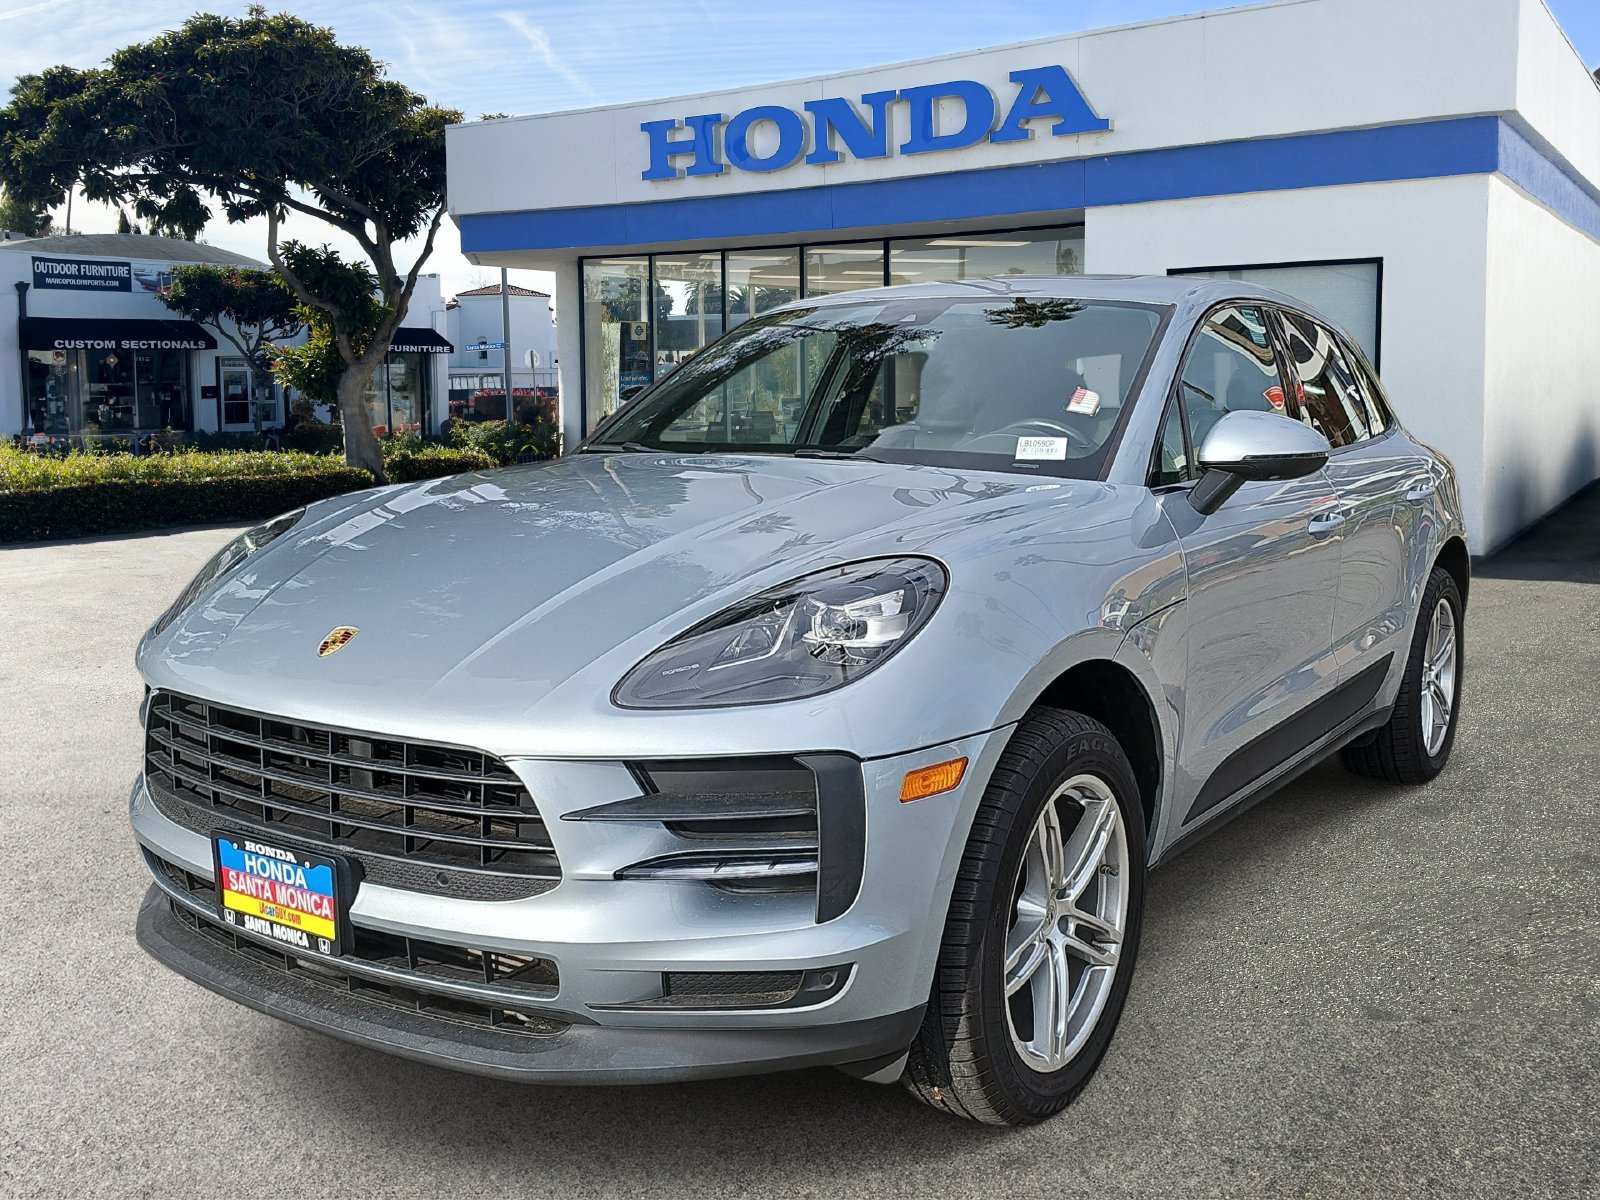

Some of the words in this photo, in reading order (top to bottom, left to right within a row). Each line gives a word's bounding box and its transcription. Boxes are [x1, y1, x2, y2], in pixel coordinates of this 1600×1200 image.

[640, 64, 1113, 182] HONDA
[34, 261, 79, 275] OUTDOOR
[80, 264, 130, 278] FURNITURE
[45, 277, 119, 287] MARCOPOLOIMPORTS.COM
[54, 339, 116, 349] CUSTOM
[121, 340, 206, 349] SECTIONALS
[388, 344, 451, 353] FURNITURE
[662, 663, 700, 676] PORSCHE
[244, 840, 297, 864] HONDA
[244, 853, 308, 890] HONDA
[228, 871, 274, 902] SANTA
[274, 882, 333, 919] MONICA
[243, 915, 273, 936] SANTA
[272, 922, 310, 948] MONICA
